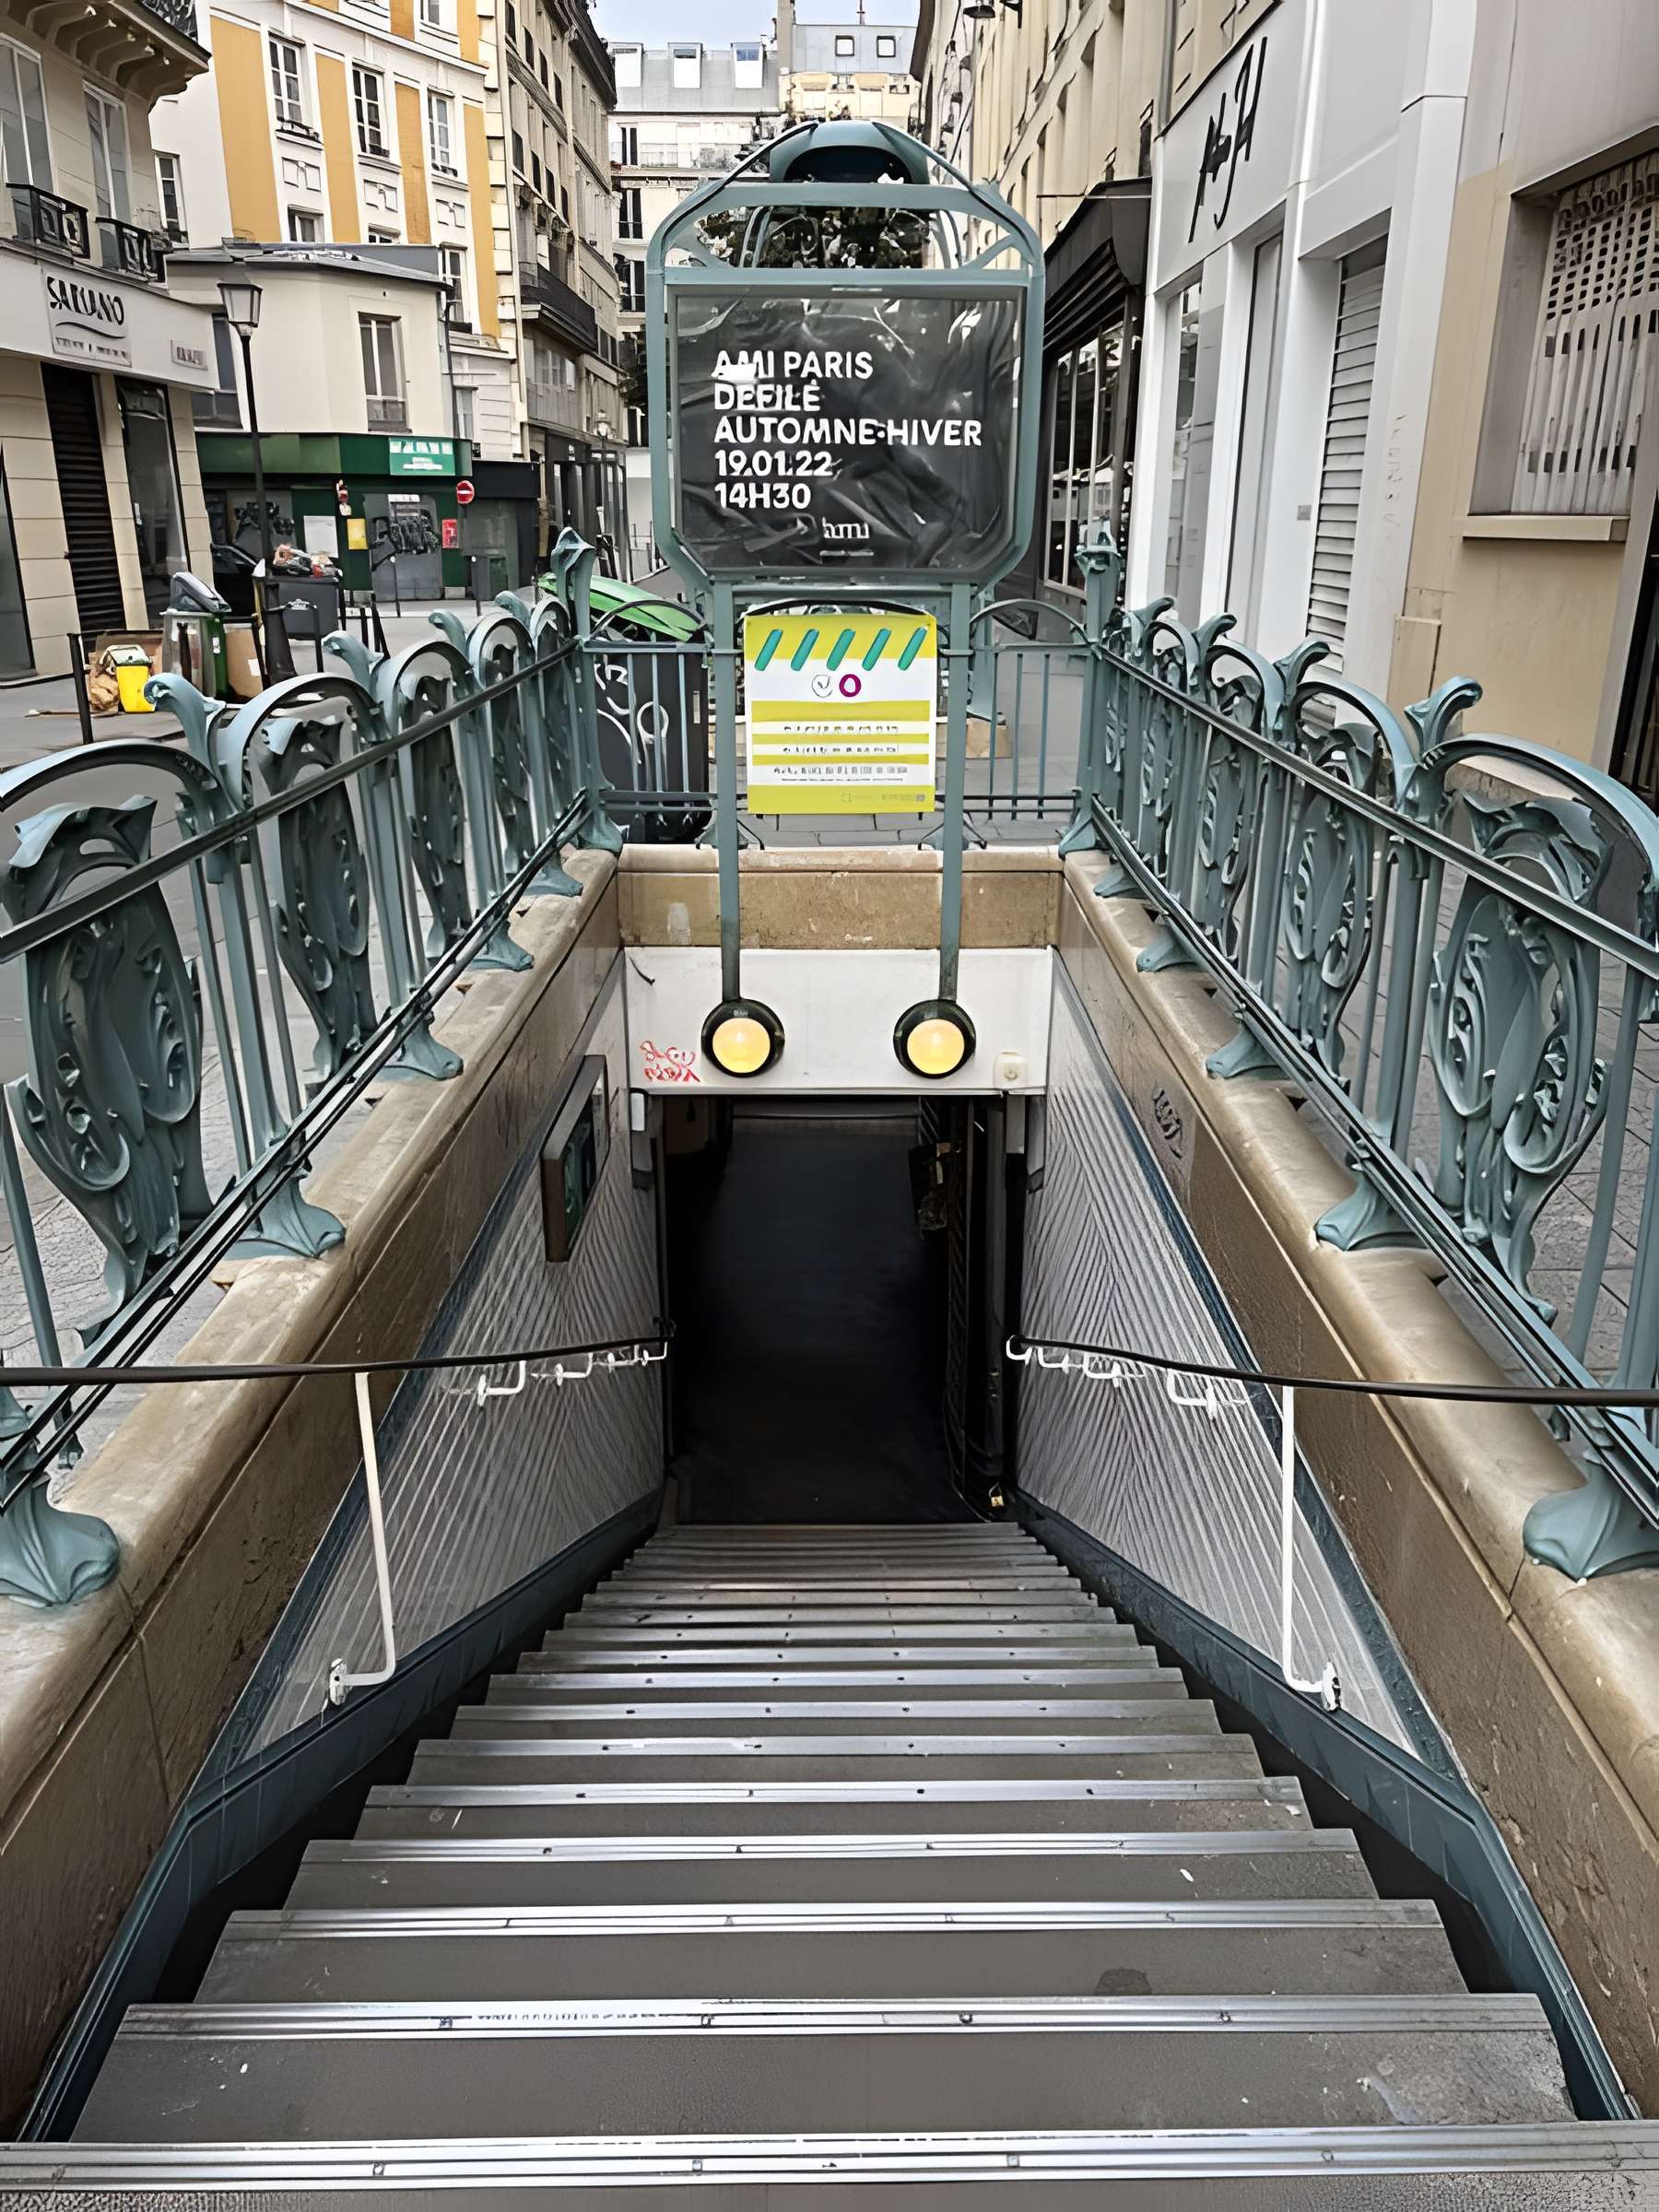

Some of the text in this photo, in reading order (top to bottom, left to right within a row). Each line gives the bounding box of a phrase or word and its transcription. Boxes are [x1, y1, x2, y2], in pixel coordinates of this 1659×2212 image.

[712, 350, 874, 379] AMI PARIS
[715, 450, 833, 477] 19.01.22
[715, 482, 811, 509] 14H30
